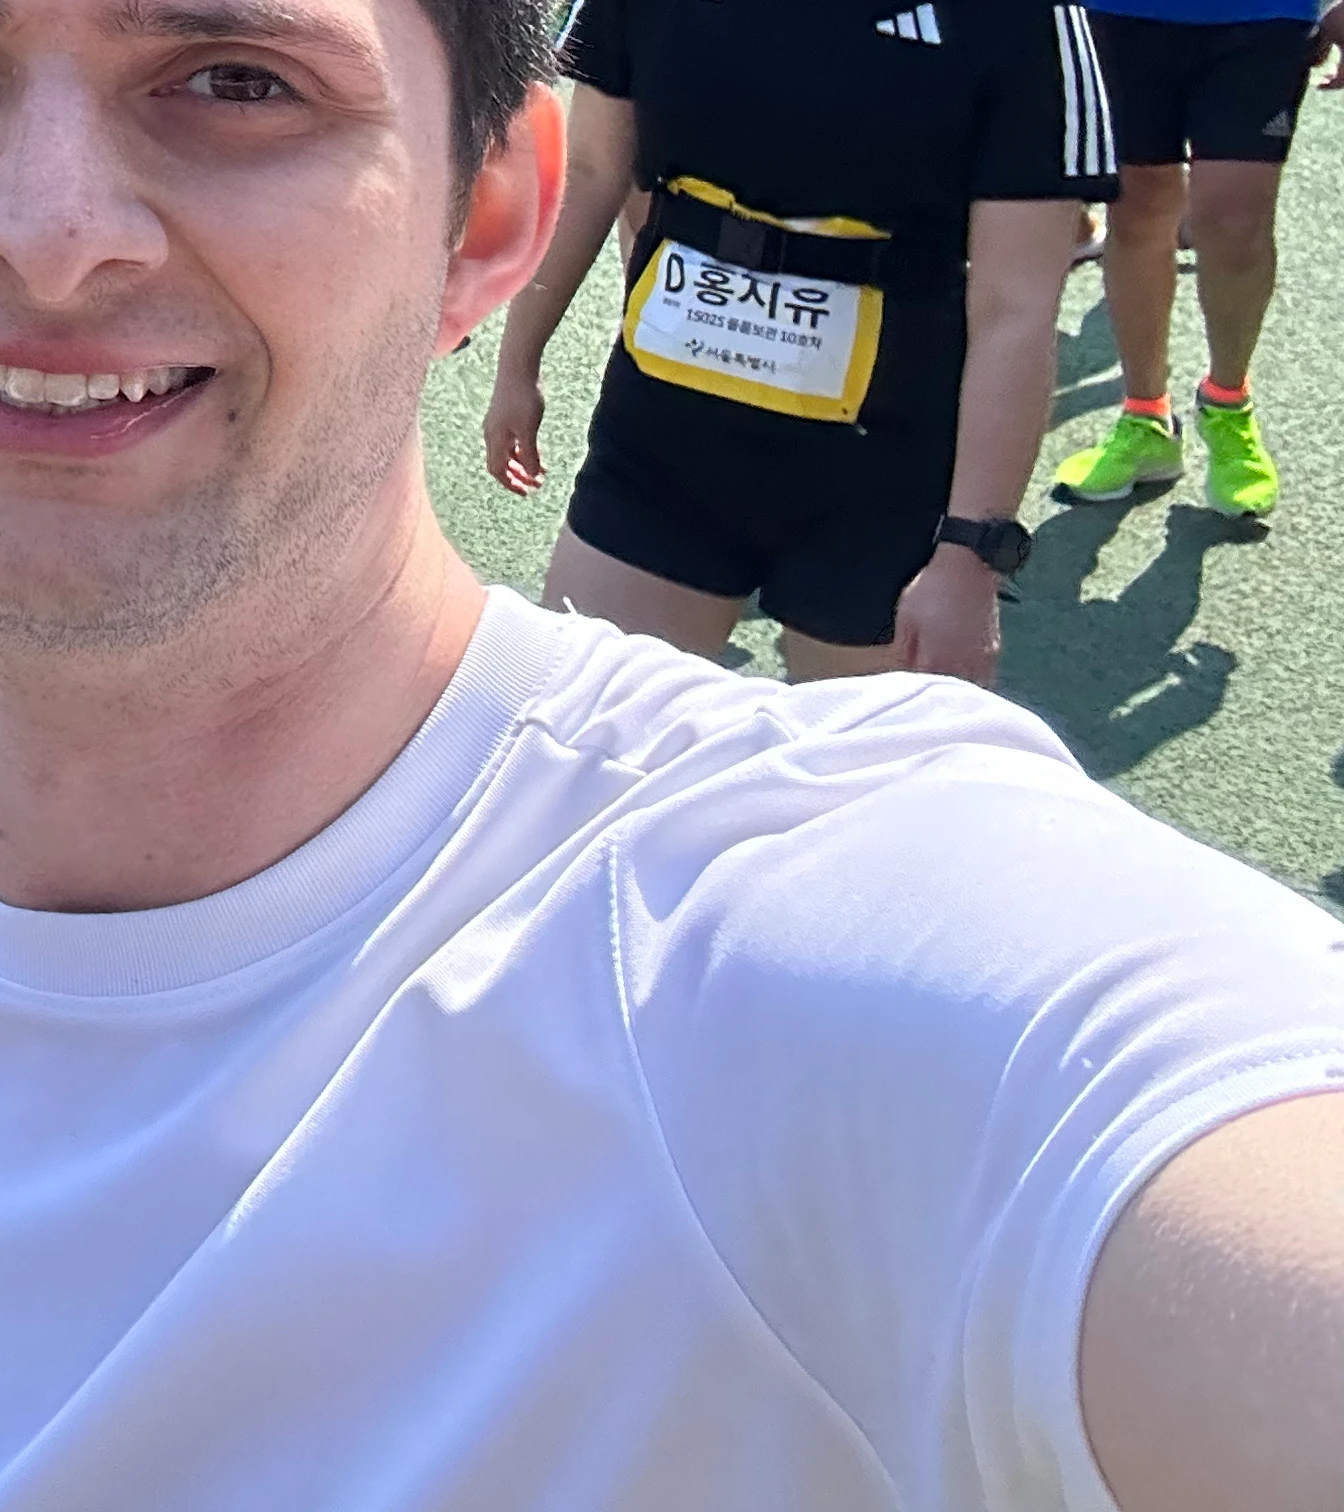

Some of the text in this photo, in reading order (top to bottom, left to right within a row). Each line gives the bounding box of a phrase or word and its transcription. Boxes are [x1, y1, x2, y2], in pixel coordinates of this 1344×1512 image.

[665, 252, 831, 329] D 홍지유
[705, 347, 777, 375] 서울특별시
